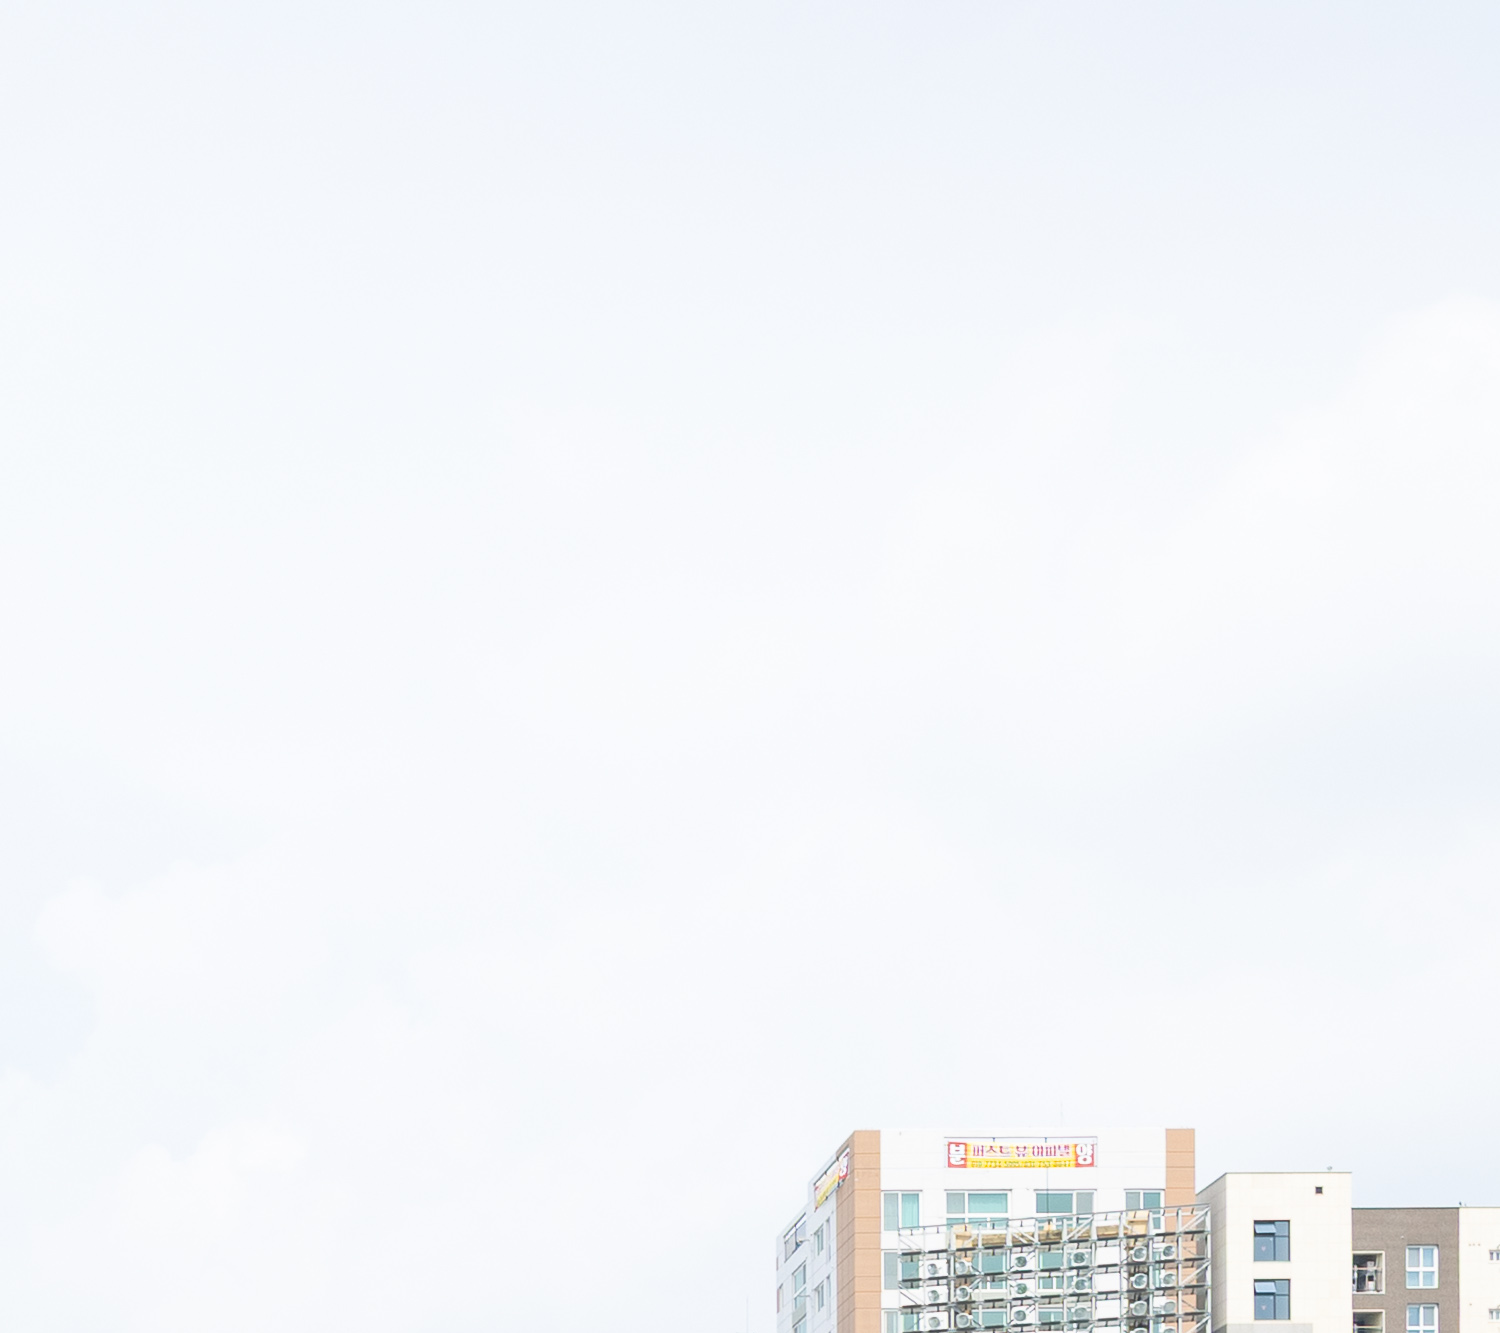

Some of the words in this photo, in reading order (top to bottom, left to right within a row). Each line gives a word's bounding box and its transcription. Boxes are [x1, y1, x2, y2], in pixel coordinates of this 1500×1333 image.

[949, 1143, 966, 1165] 분
[972, 1145, 1010, 1157] 퍼스트
[1016, 1145, 1027, 1157] 뷰
[1075, 1143, 1094, 1165] 양
